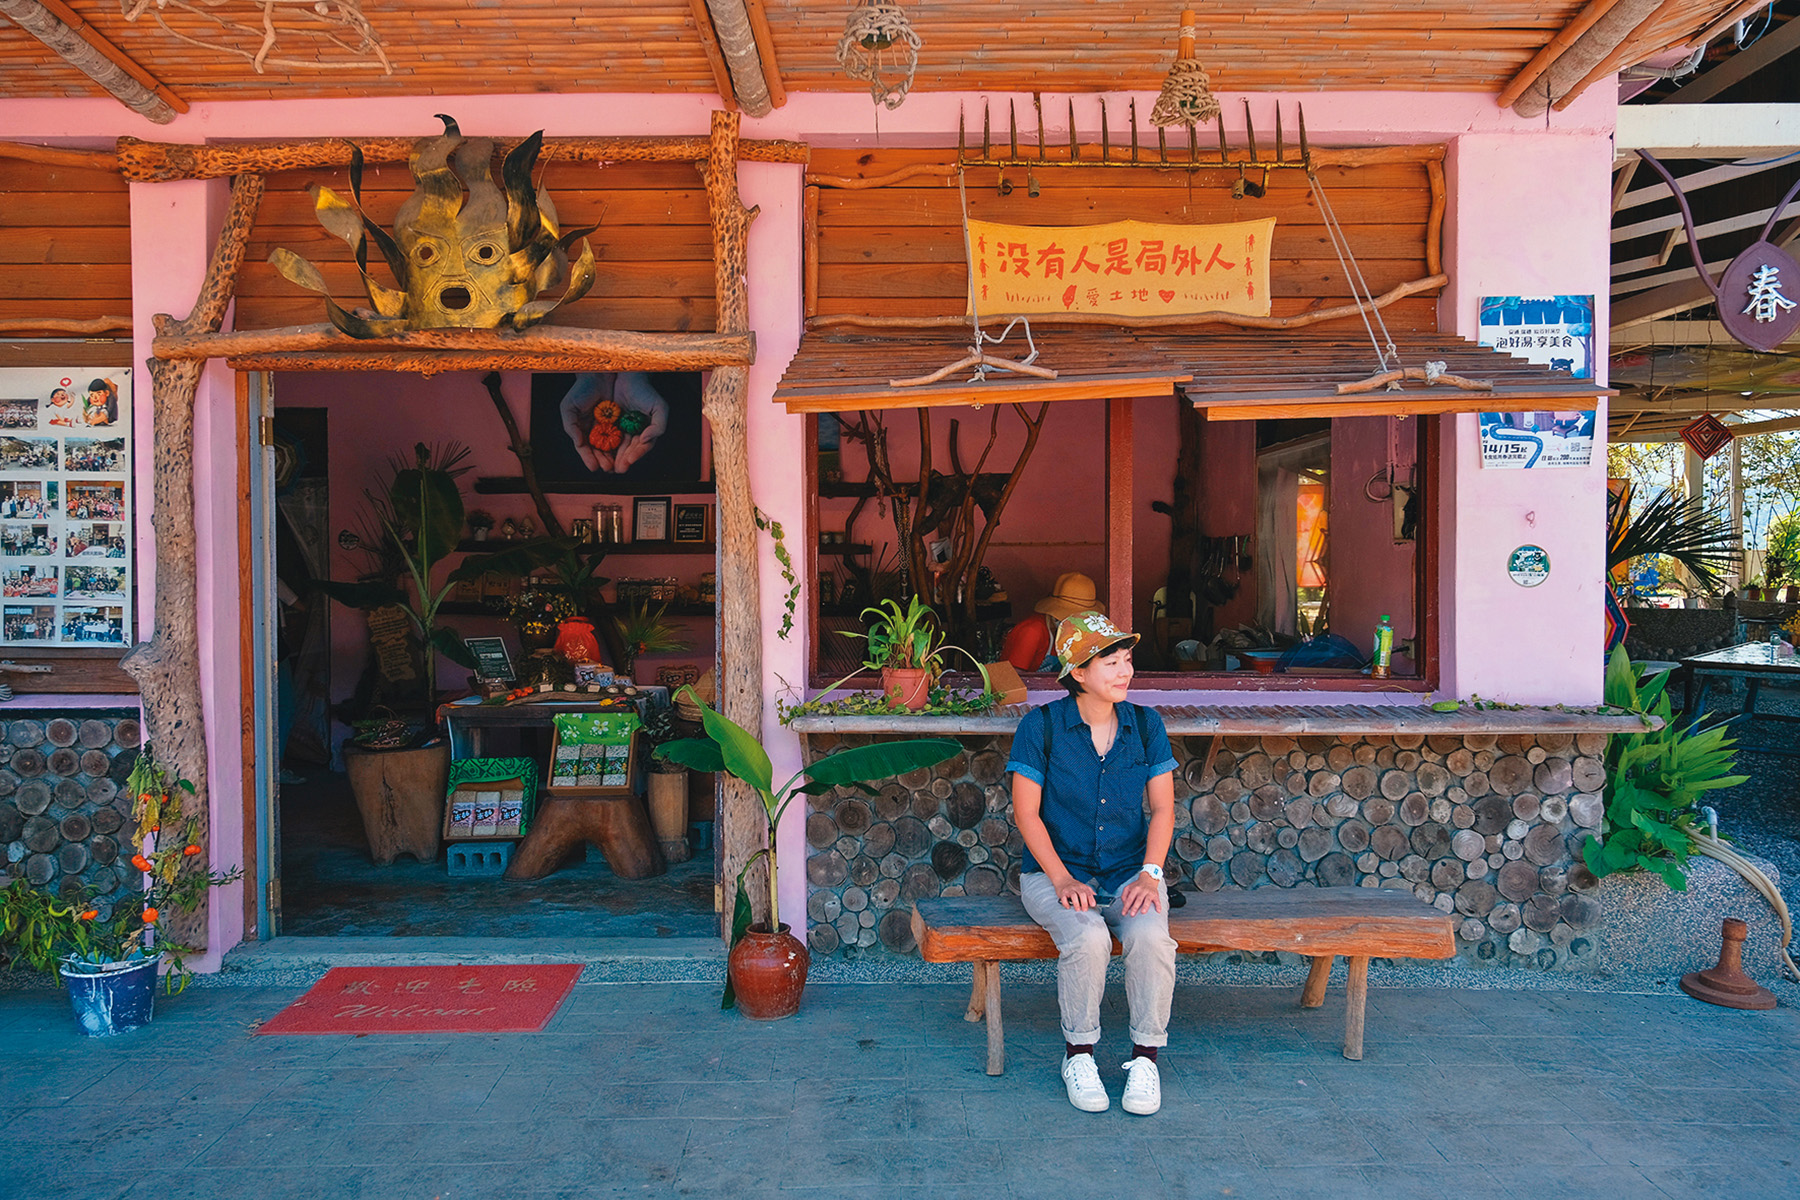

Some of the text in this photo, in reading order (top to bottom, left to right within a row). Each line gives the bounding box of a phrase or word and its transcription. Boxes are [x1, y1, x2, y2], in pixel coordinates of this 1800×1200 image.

[1086, 287, 1149, 308] 愛土地
[1743, 264, 1797, 322] 春
